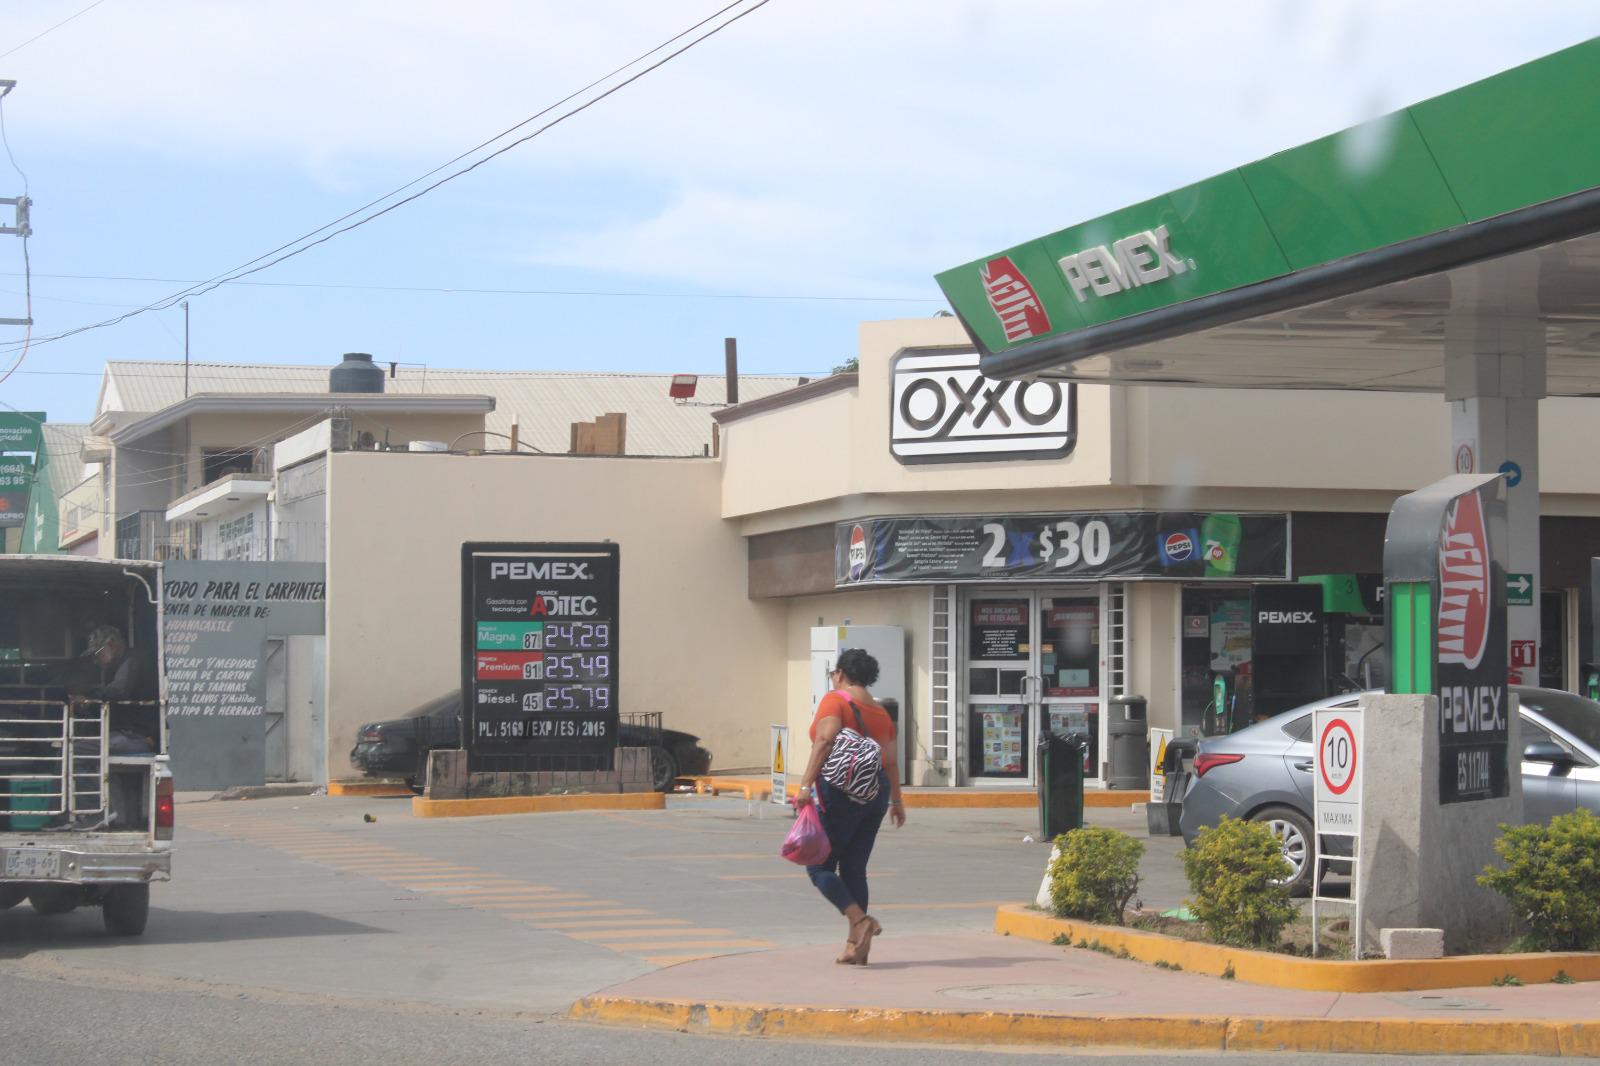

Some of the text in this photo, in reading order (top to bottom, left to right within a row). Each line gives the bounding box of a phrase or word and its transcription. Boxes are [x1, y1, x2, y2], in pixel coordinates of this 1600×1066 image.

[1058, 225, 1187, 302] PEMEX
[899, 376, 1063, 434] OXXO
[982, 523, 1006, 567] 2
[1040, 521, 1110, 567] $30
[1167, 542, 1191, 552] PEPSI
[491, 562, 588, 580] PEMEX
[164, 580, 198, 599] TODO
[203, 581, 240, 600] PARA
[245, 582, 260, 600] EL
[163, 603, 189, 616] ENTA
[193, 604, 207, 617] DE
[210, 605, 250, 618] MADERA
[1258, 611, 1313, 624] PEMEX
[478, 631, 516, 644] Magna
[524, 633, 537, 648] 87
[545, 624, 609, 647] 24.29
[166, 657, 201, 669] RIPLAY
[478, 661, 520, 671] Premium
[545, 655, 609, 678] 25.49
[167, 670, 253, 681] AMINA DE CARTON
[525, 664, 538, 678] 91
[168, 682, 247, 693] ENTA DE TARIMAS
[524, 695, 538, 709] 45
[545, 687, 609, 709] 25.79
[168, 707, 180, 716] DO
[204, 706, 216, 716] DE
[1441, 686, 1501, 733] PEMEX
[1327, 736, 1348, 769] 10
[1458, 752, 1467, 790] ES
[1323, 812, 1353, 825] MAXIMA
